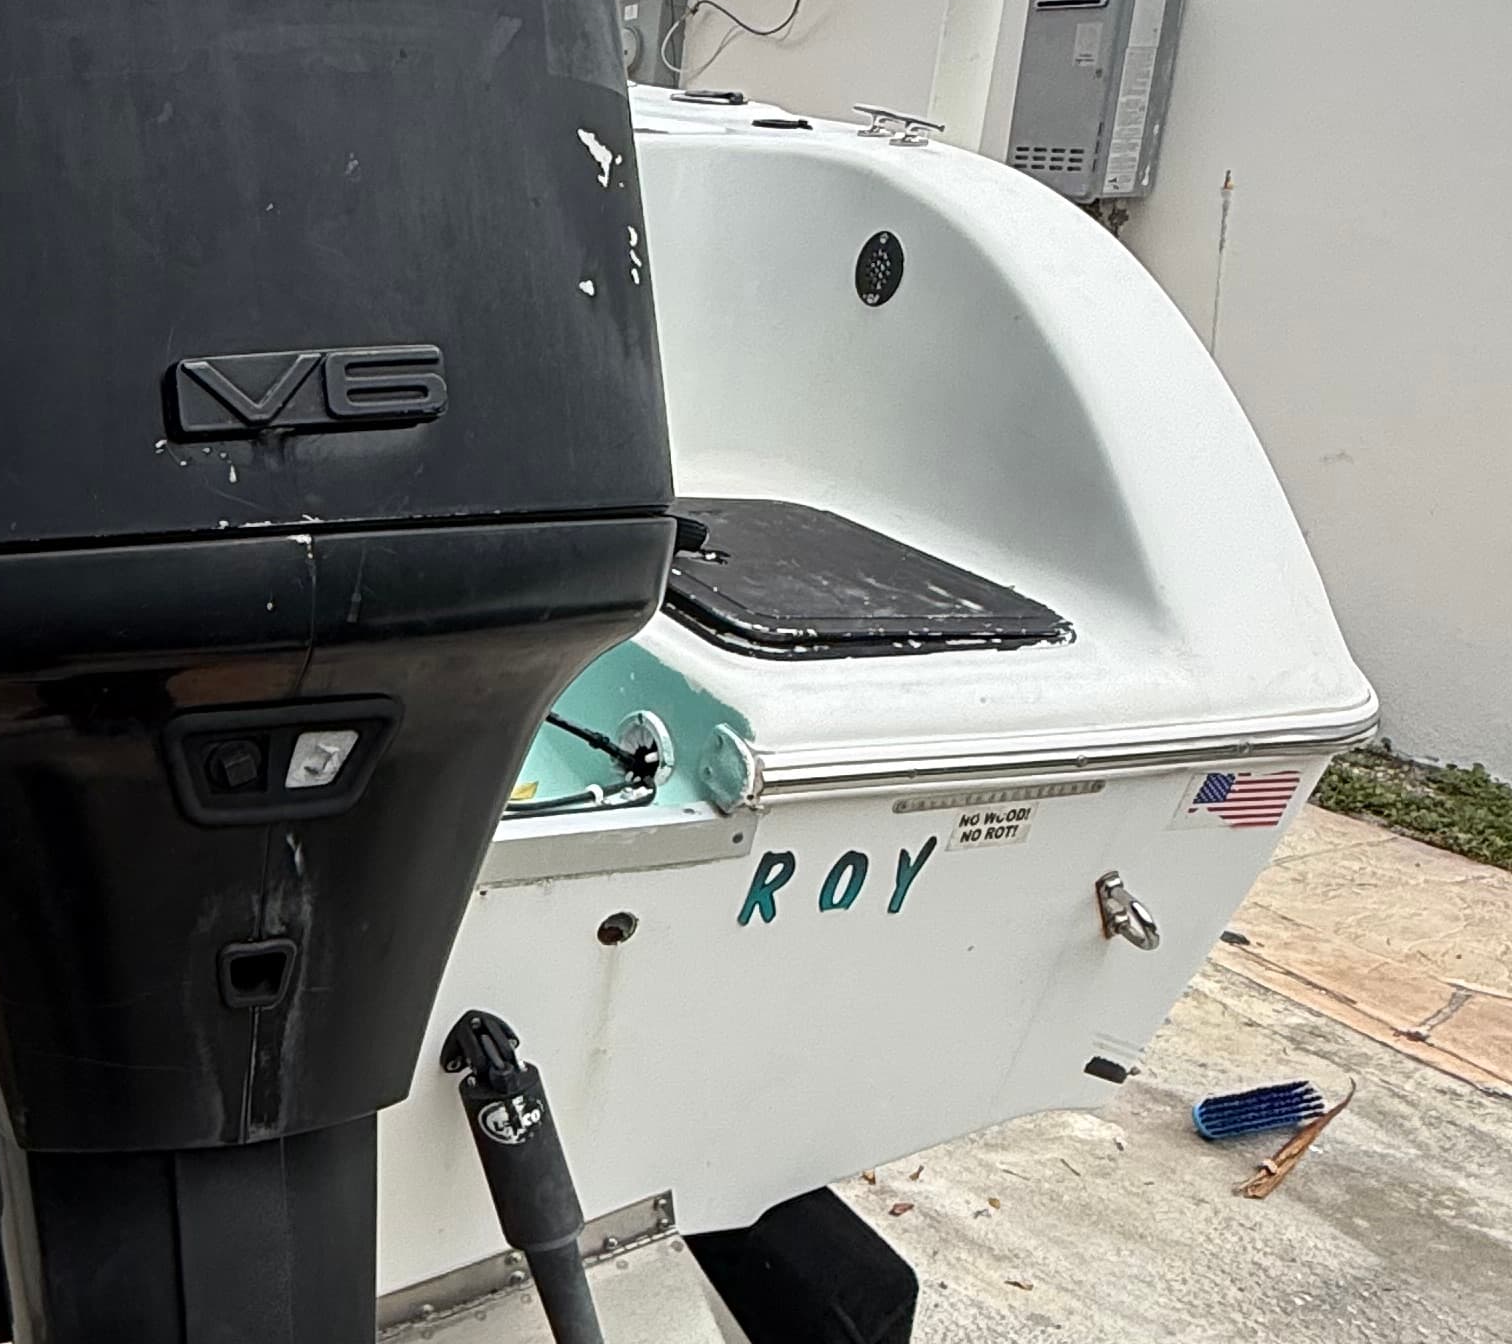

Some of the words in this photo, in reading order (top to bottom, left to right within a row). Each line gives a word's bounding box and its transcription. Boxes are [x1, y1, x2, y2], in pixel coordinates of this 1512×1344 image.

[181, 344, 448, 422] V6
[958, 812, 981, 828] NO
[959, 828, 983, 844] NO
[984, 824, 1020, 841] ROT!
[737, 835, 938, 926] ROY
